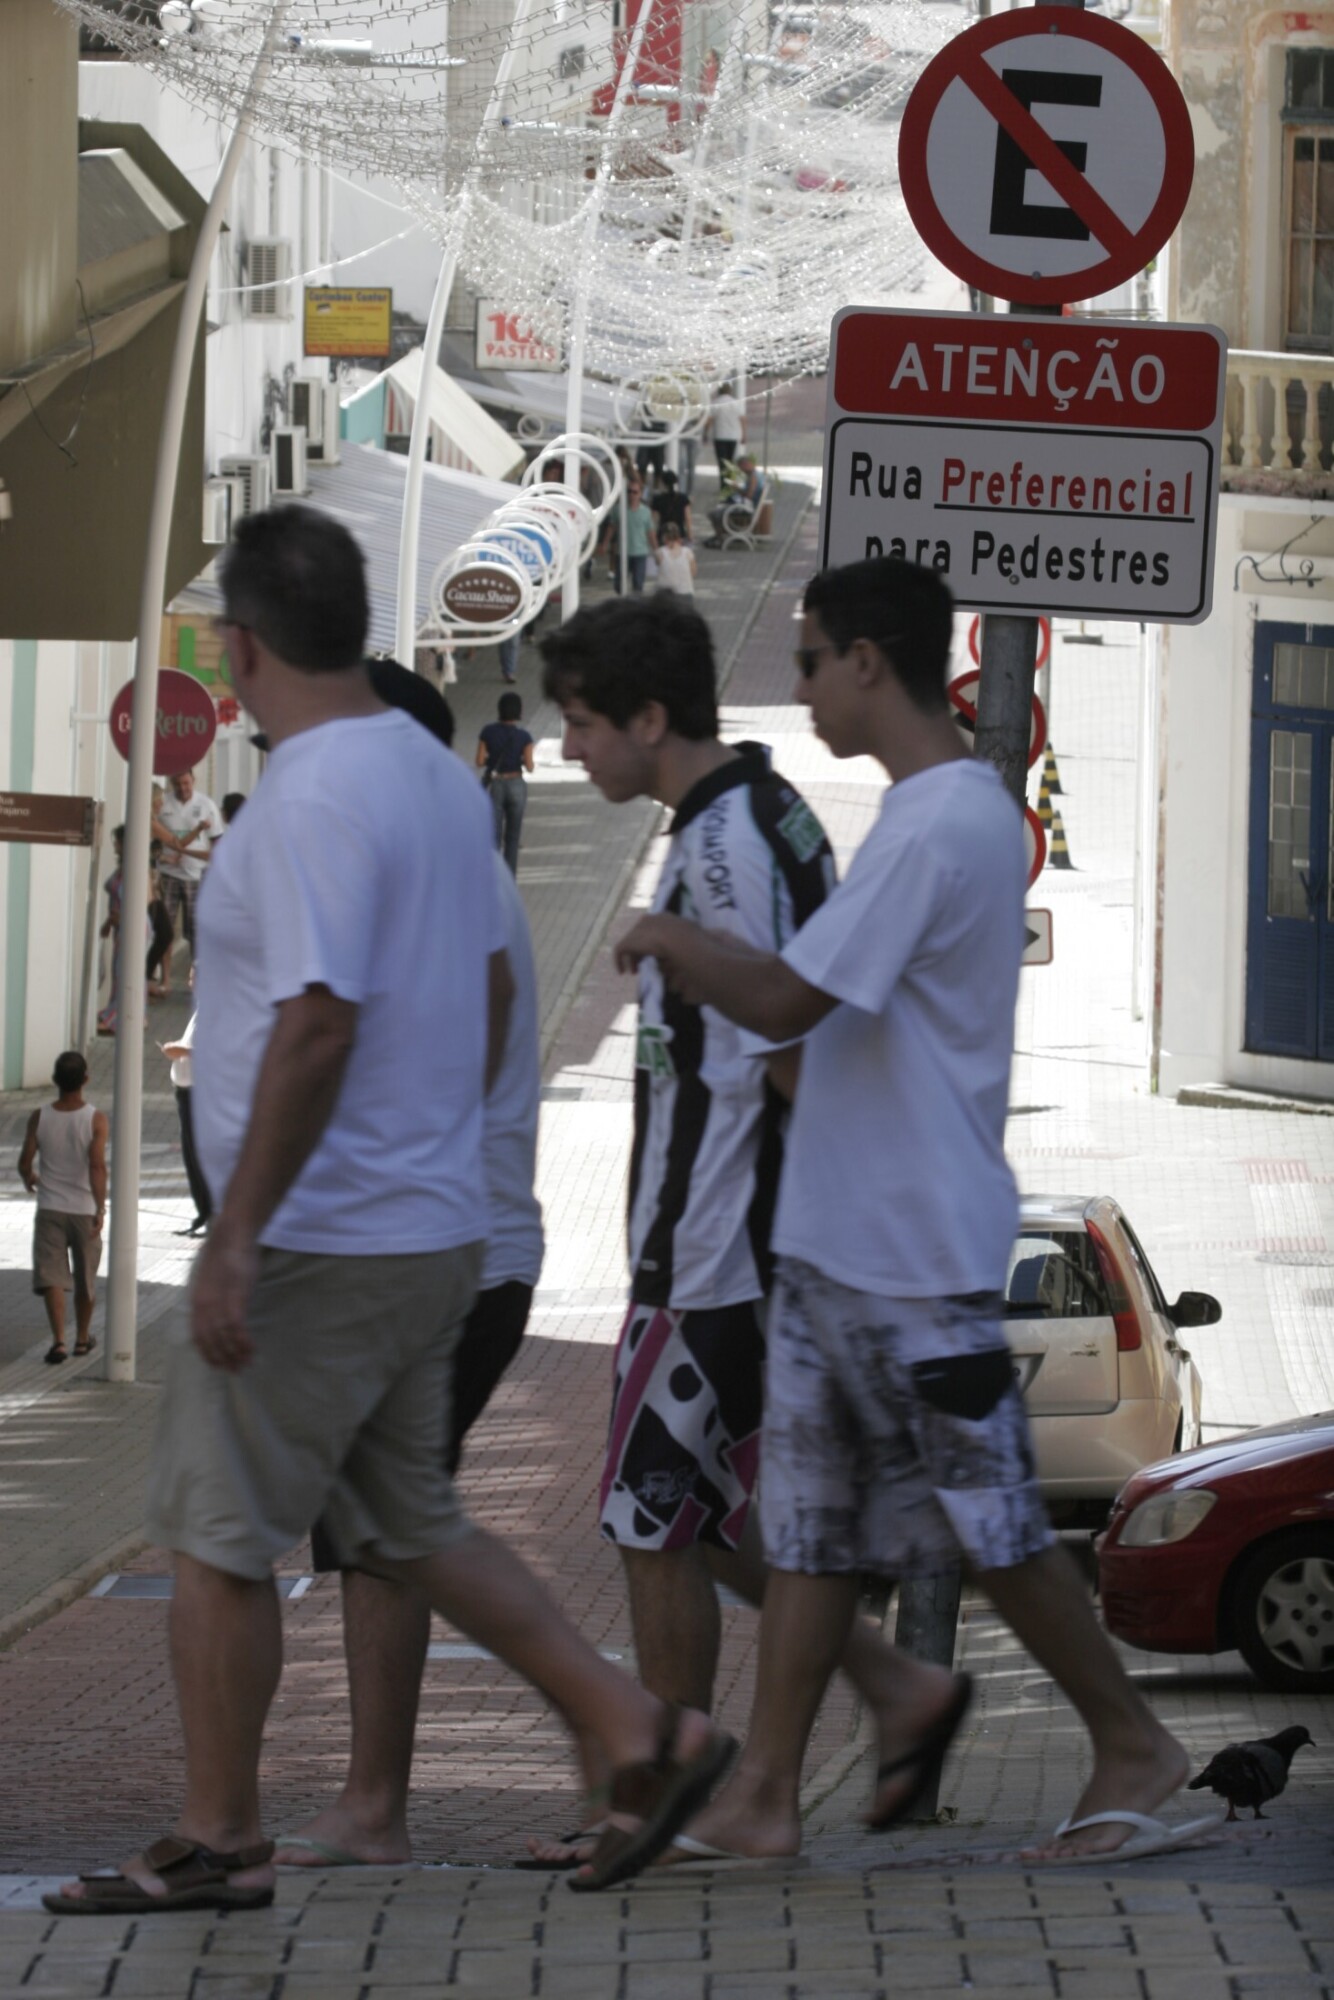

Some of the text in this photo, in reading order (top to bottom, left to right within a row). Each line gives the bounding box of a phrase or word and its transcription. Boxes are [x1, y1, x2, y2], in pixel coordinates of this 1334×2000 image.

[989, 68, 1103, 242] E
[889, 338, 1165, 411] ATENÇÃO
[849, 451, 1194, 515] Rua Preferencial
[971, 530, 1170, 586] Pedestres
[447, 587, 518, 605] Cacau Show
